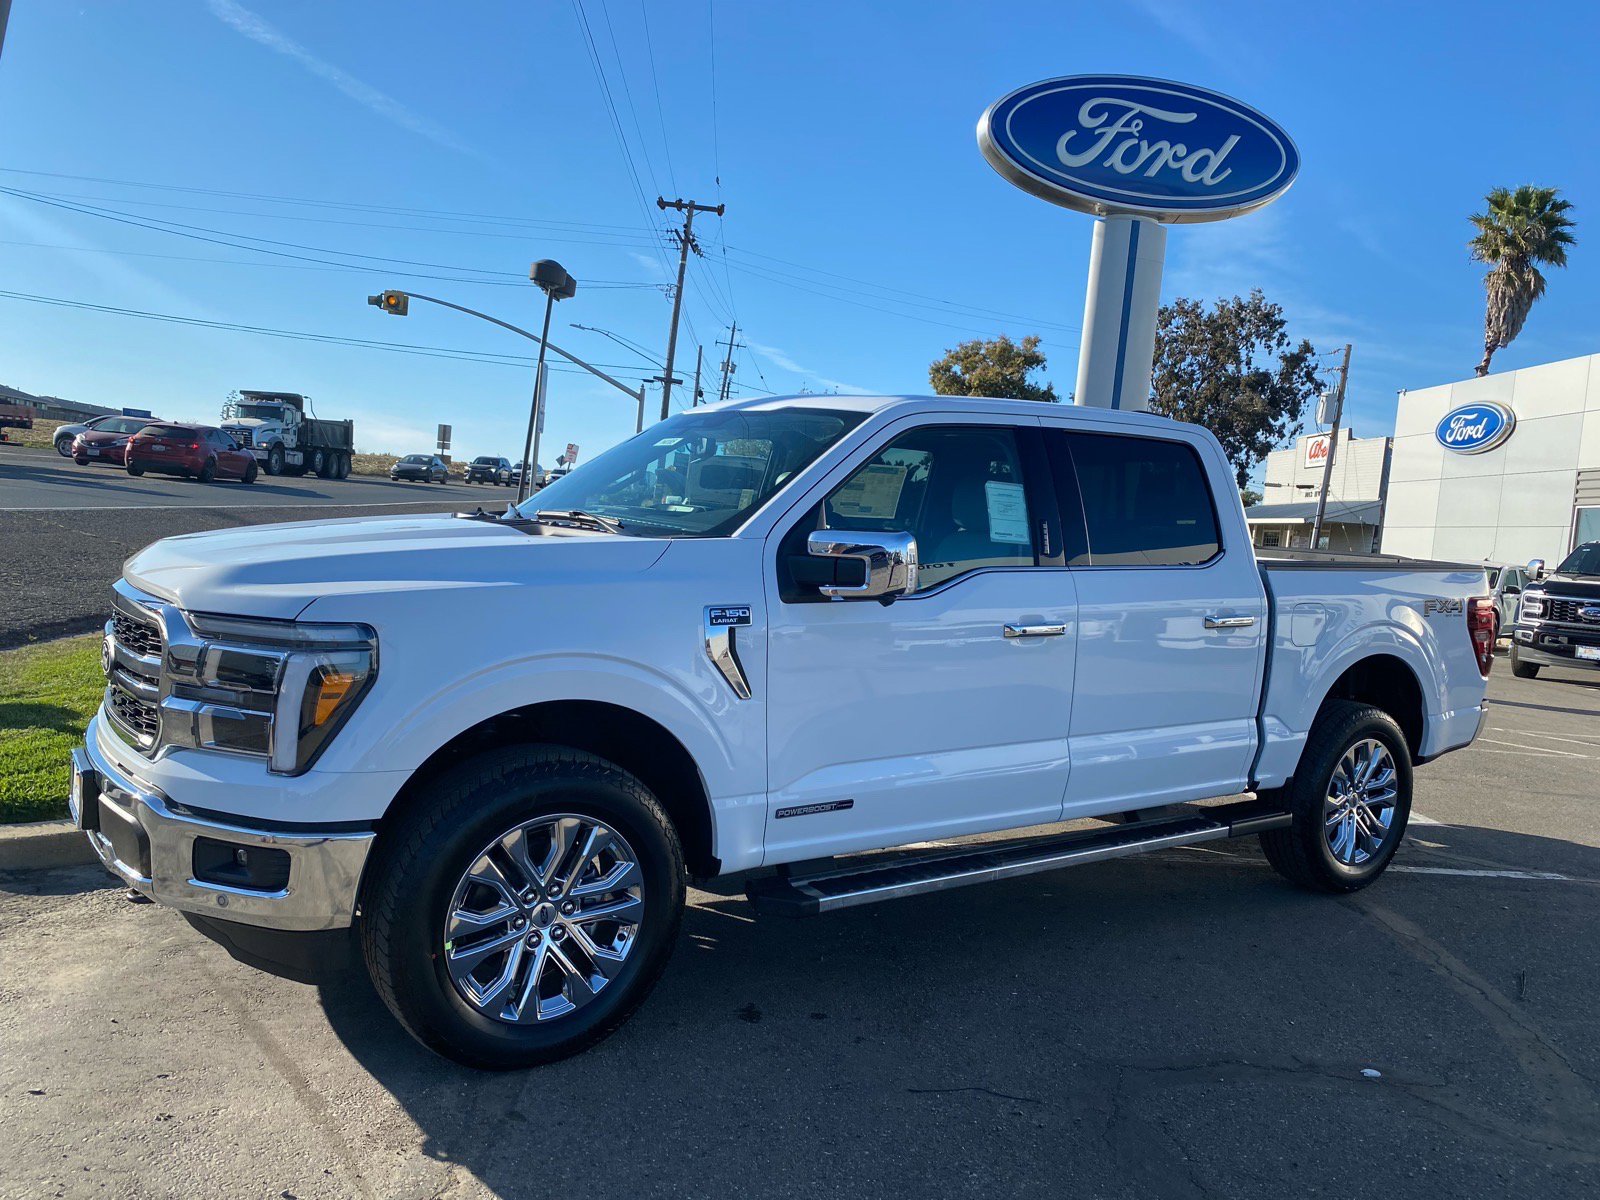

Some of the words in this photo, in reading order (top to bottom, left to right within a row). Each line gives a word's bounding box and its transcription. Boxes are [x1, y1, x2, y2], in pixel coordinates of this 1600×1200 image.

[1056, 97, 1241, 186] Ford
[1446, 413, 1487, 442] Ford
[710, 609, 750, 618] F-150
[1424, 598, 1463, 617] FX4
[777, 803, 837, 817] POWERBOOST
